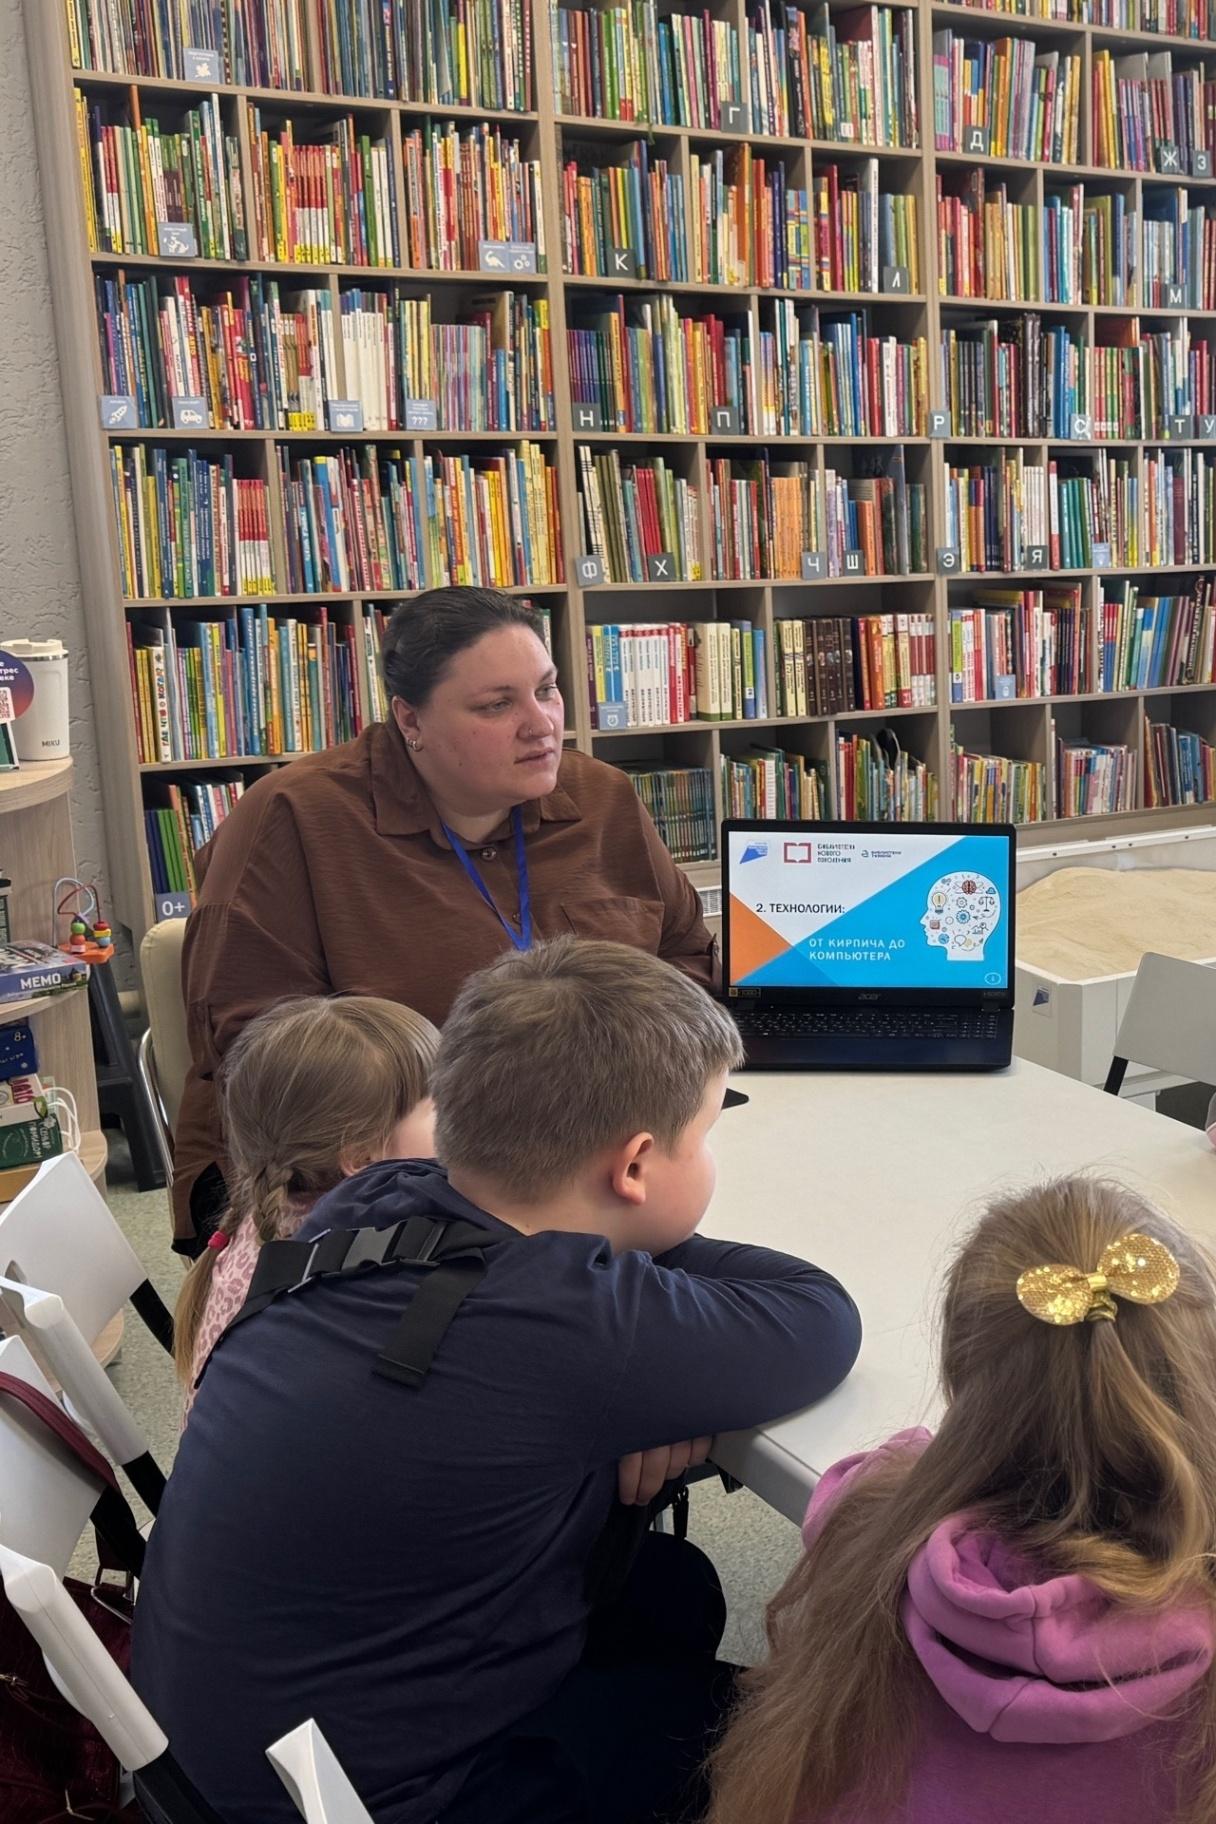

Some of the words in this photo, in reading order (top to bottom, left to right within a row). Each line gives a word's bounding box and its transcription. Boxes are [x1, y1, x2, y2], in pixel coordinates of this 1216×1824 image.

[729, 107, 741, 124] Г
[969, 130, 985, 152] Д
[1162, 151, 1178, 167] Ж
[1197, 154, 1207, 170] З
[614, 253, 629, 271] К
[891, 271, 901, 289] Л
[1169, 287, 1183, 304] М
[579, 410, 594, 428] Н
[716, 410, 730, 428] П
[933, 415, 945, 431] Р
[1173, 418, 1186, 434] Т
[1203, 418, 1216, 434] У
[807, 557, 820, 572] Ч
[846, 555, 859, 570] Ш
[942, 551, 956, 568] Э
[1031, 550, 1043, 564] Я
[581, 561, 598, 580] Ф
[654, 559, 668, 577] Х
[162, 900, 185, 917] 0+
[756, 903, 767, 913] 2.
[770, 903, 846, 914] ТЕХНОЛОГИИ:
[809, 938, 823, 948] ОТ
[828, 938, 885, 949] КИРПИЧА
[889, 939, 905, 949] ДО
[809, 951, 891, 961] КОМПЬЮТЕРА
[20, 973, 62, 990] MEMO
